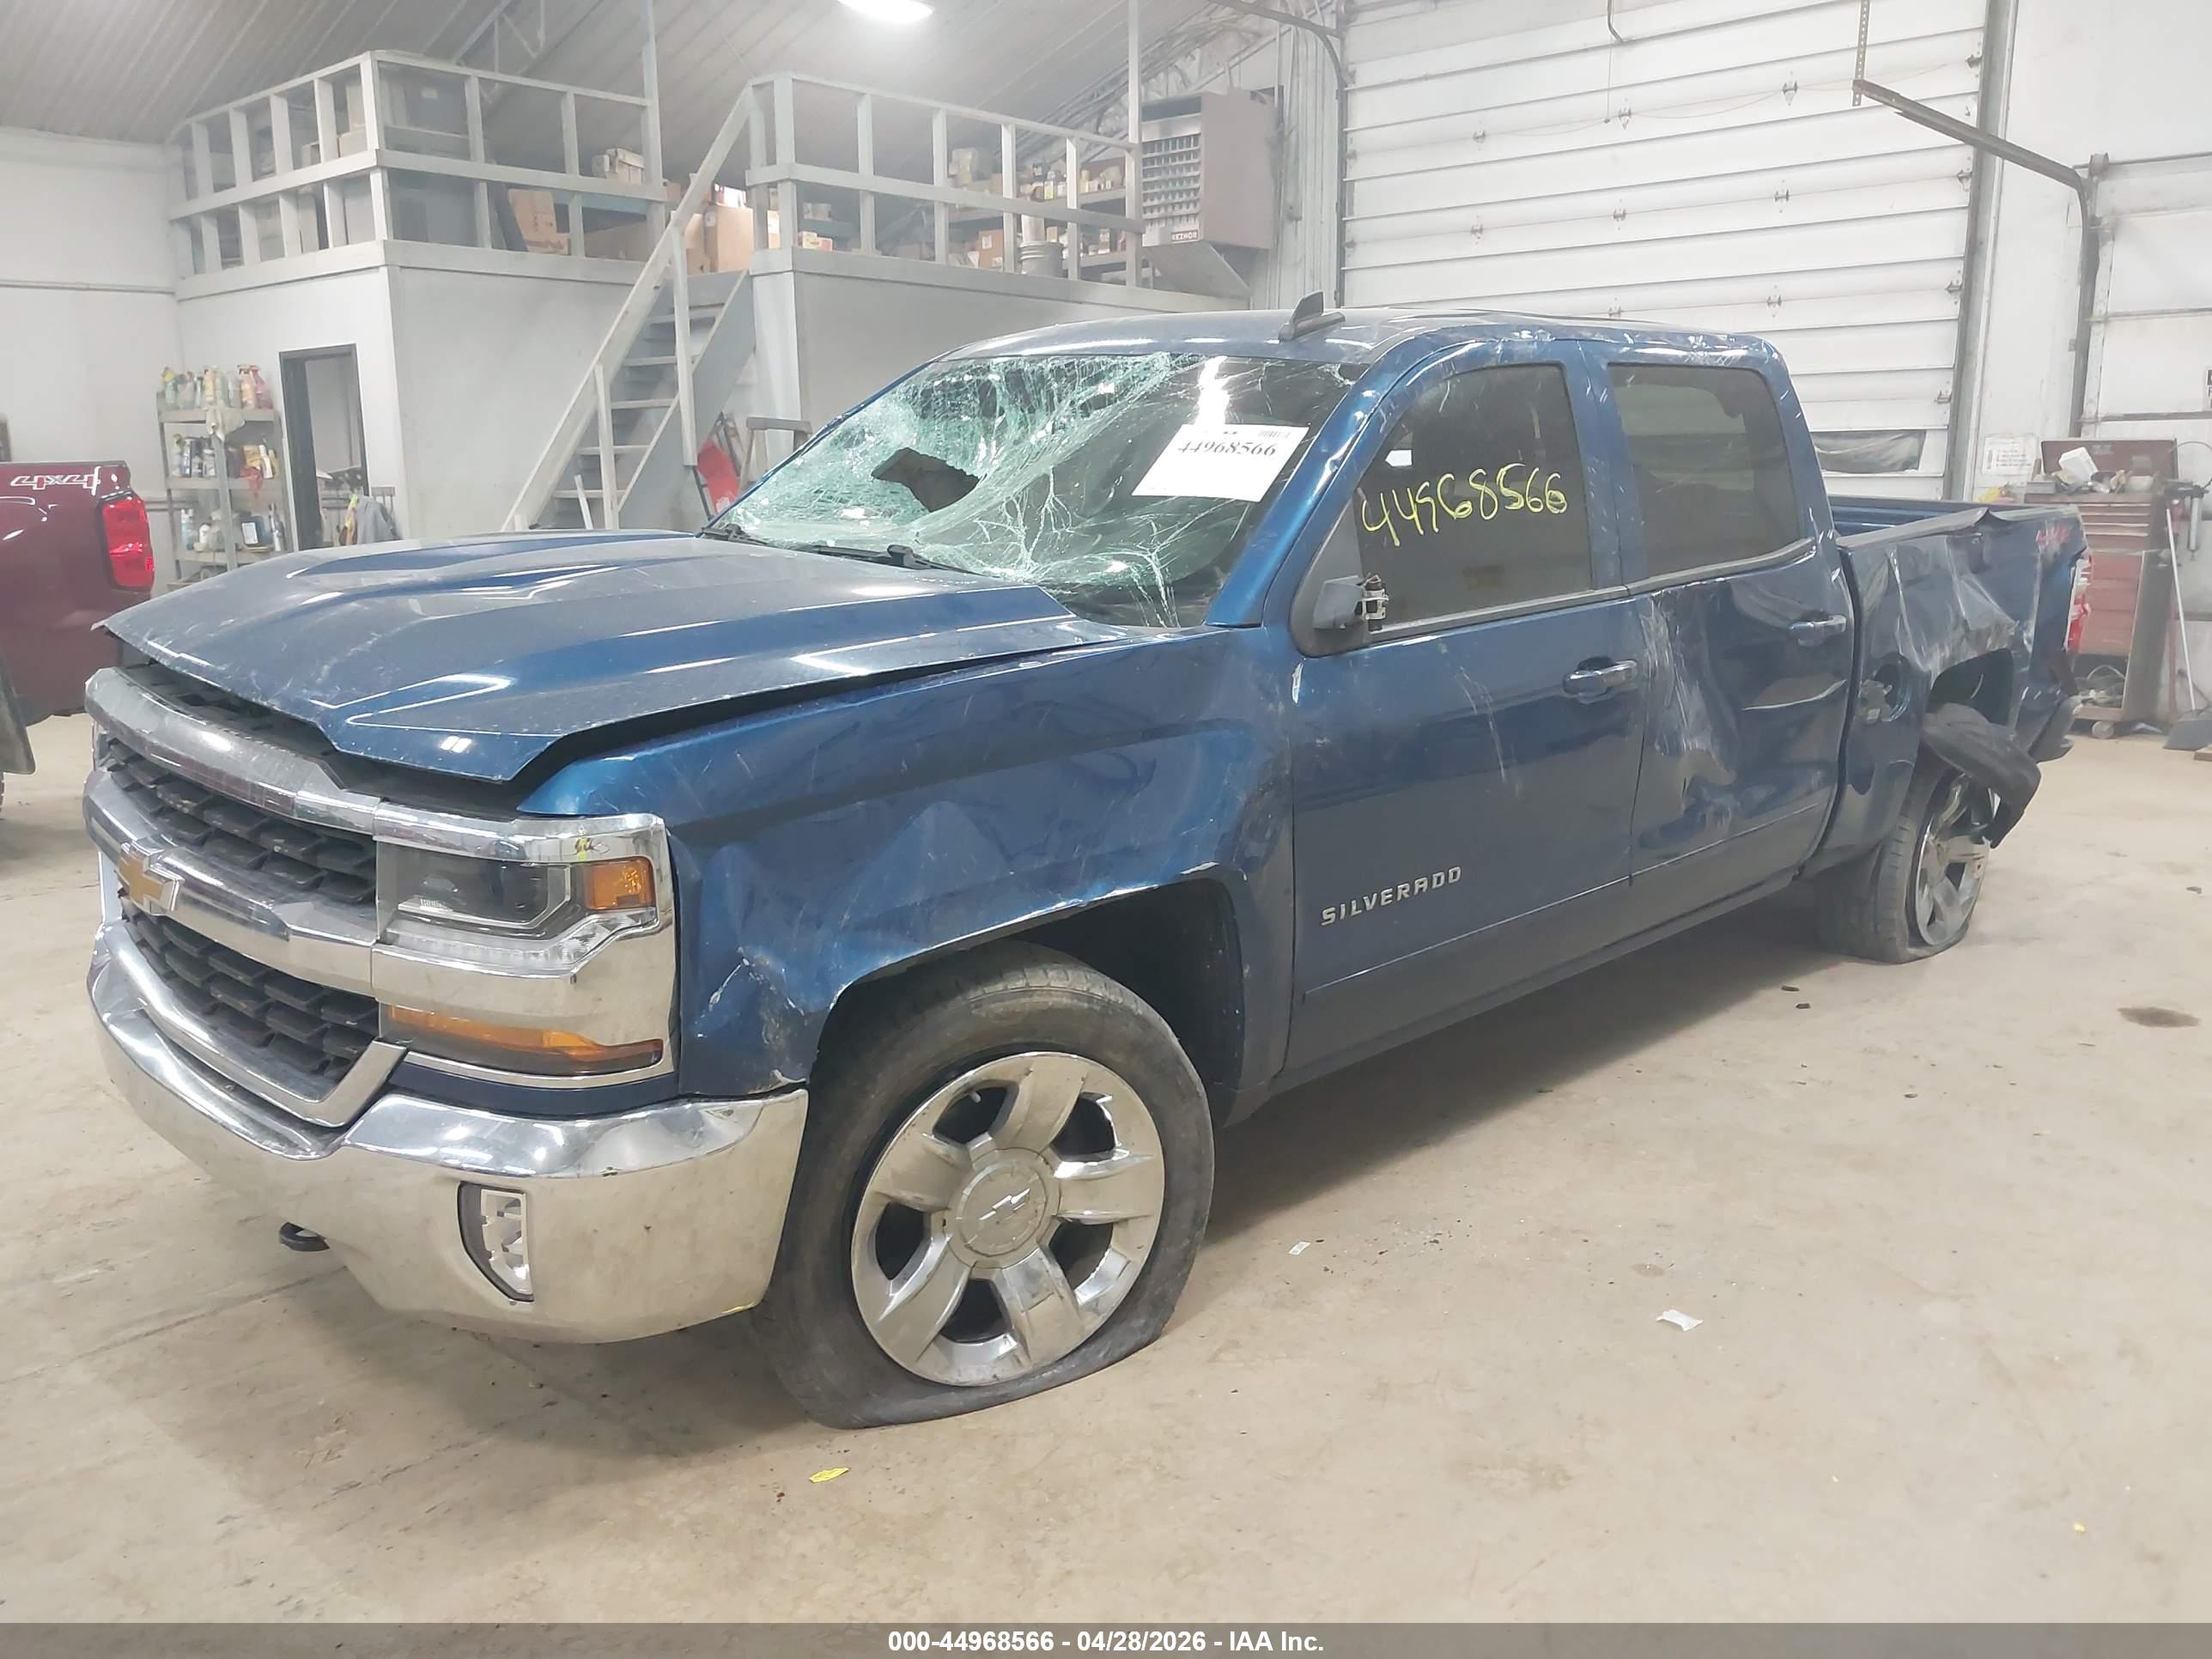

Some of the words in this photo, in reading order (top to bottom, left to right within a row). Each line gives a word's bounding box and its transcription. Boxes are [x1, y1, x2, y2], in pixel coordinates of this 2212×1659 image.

[1177, 441, 1277, 457] 44968566
[1362, 463, 1568, 547] 44968566
[1321, 866, 1462, 926] SILVERADO
